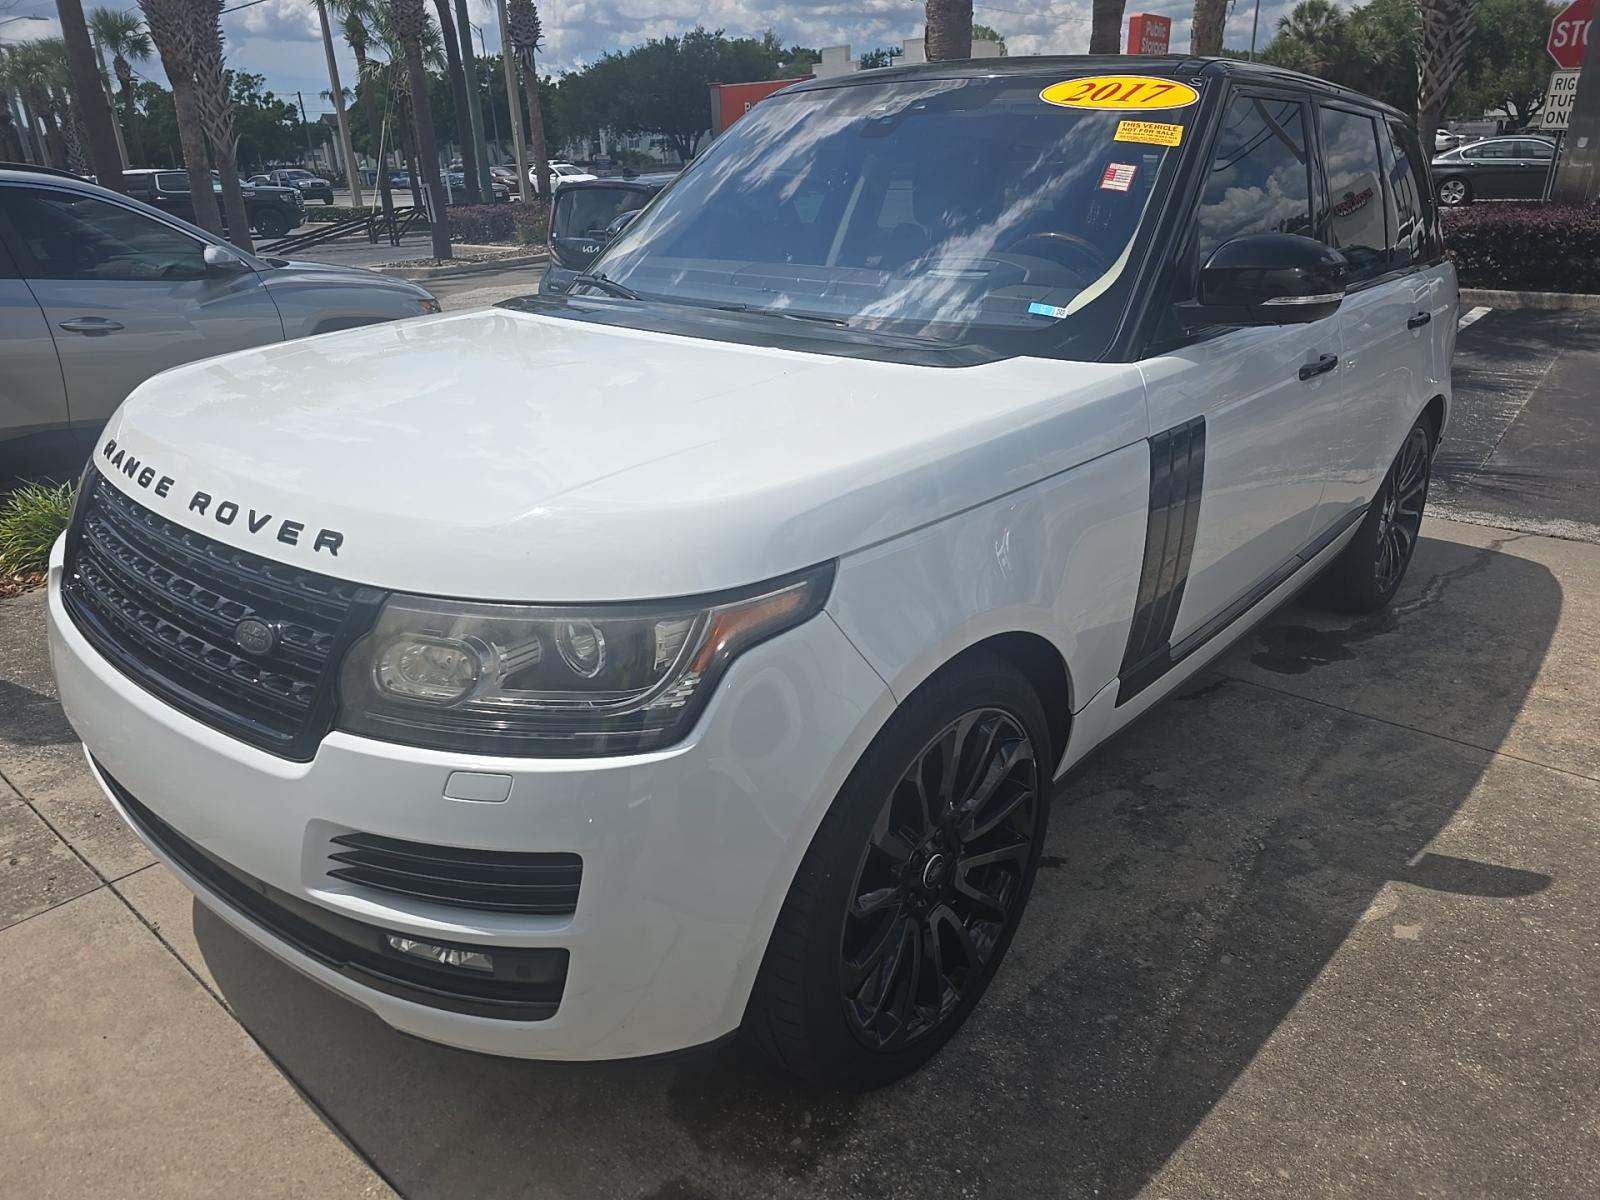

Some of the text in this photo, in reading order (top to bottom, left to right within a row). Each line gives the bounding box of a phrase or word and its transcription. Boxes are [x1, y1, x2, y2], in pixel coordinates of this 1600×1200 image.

[1061, 82, 1177, 103] 2017
[1143, 123, 1178, 132] VEHICLE
[102, 439, 345, 557] RANGE ROVER
